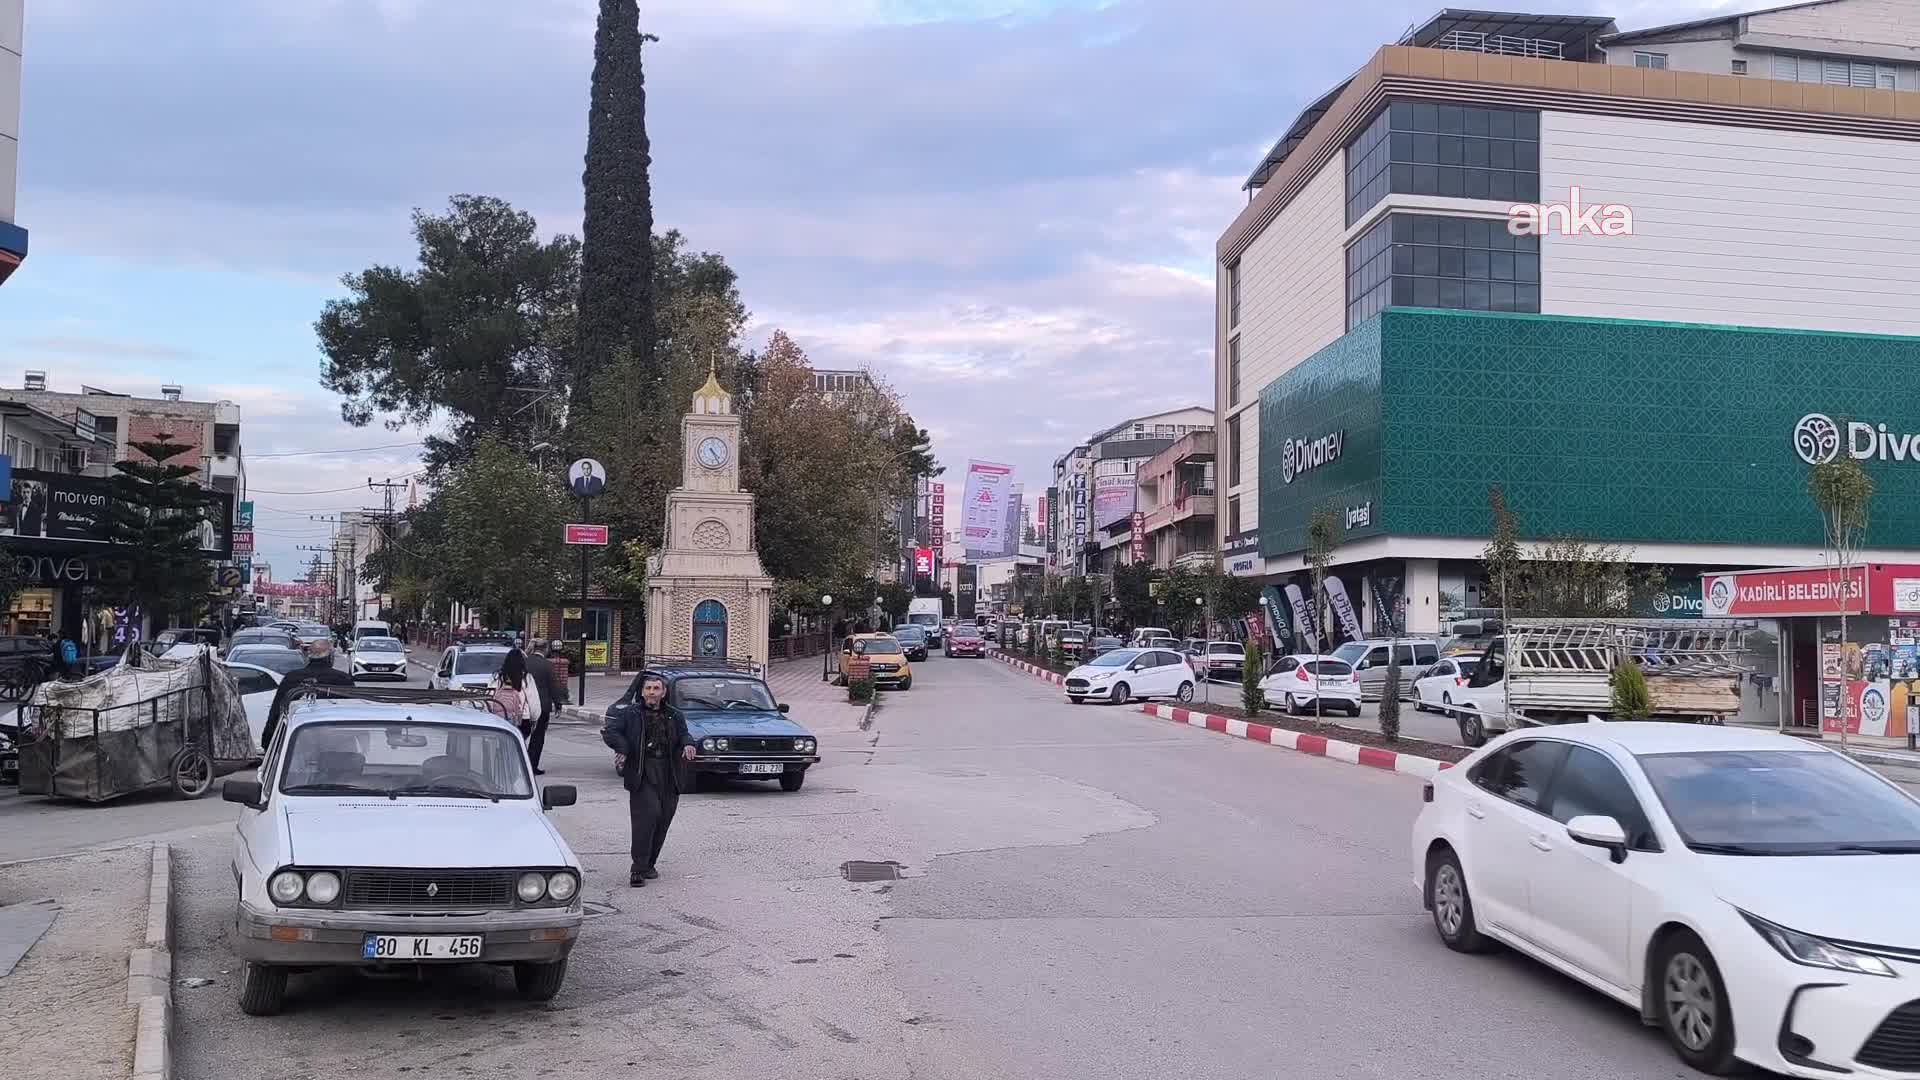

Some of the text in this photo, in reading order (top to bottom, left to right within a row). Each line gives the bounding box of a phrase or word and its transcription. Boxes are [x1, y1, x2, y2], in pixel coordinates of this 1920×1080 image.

[1296, 429, 1343, 473] Divanev
[54, 491, 105, 505] morven
[1740, 580, 1785, 602] KADİRLİ
[375, 938, 397, 956] 80
[413, 938, 433, 956] KL
[449, 938, 480, 956] 456
